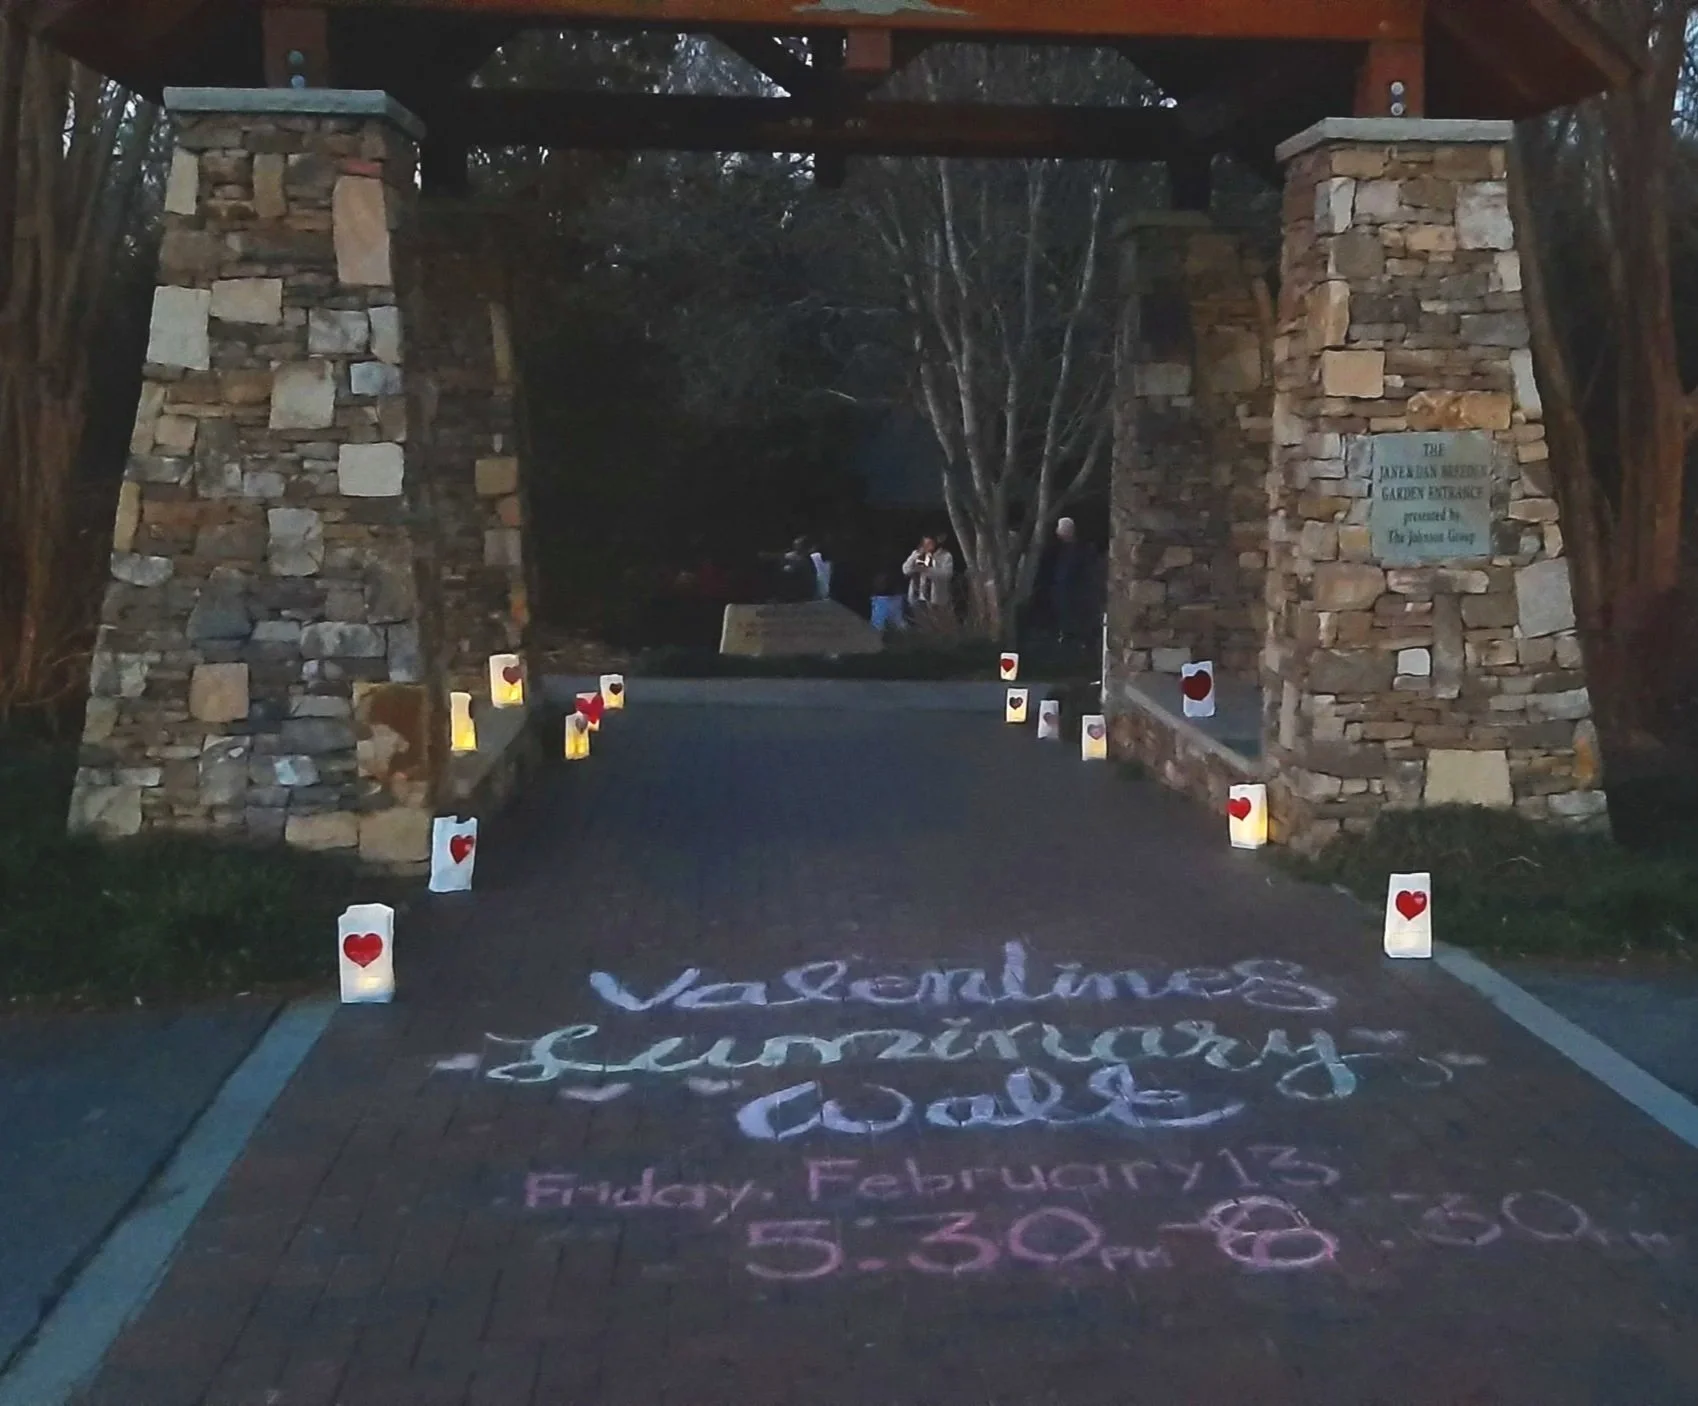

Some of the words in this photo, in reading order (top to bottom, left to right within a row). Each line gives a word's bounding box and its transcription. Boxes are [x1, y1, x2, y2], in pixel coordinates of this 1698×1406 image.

[1423, 442, 1445, 457] THE
[1381, 486, 1424, 501] GARDEN
[1428, 485, 1484, 501] ENTRANCE
[1403, 507, 1447, 527] presented
[1388, 528, 1404, 544] The
[485, 1022, 1384, 1099] Luminary
[735, 1065, 1244, 1138] Walk
[809, 1156, 1203, 1200] February
[1217, 1145, 1341, 1187] 13
